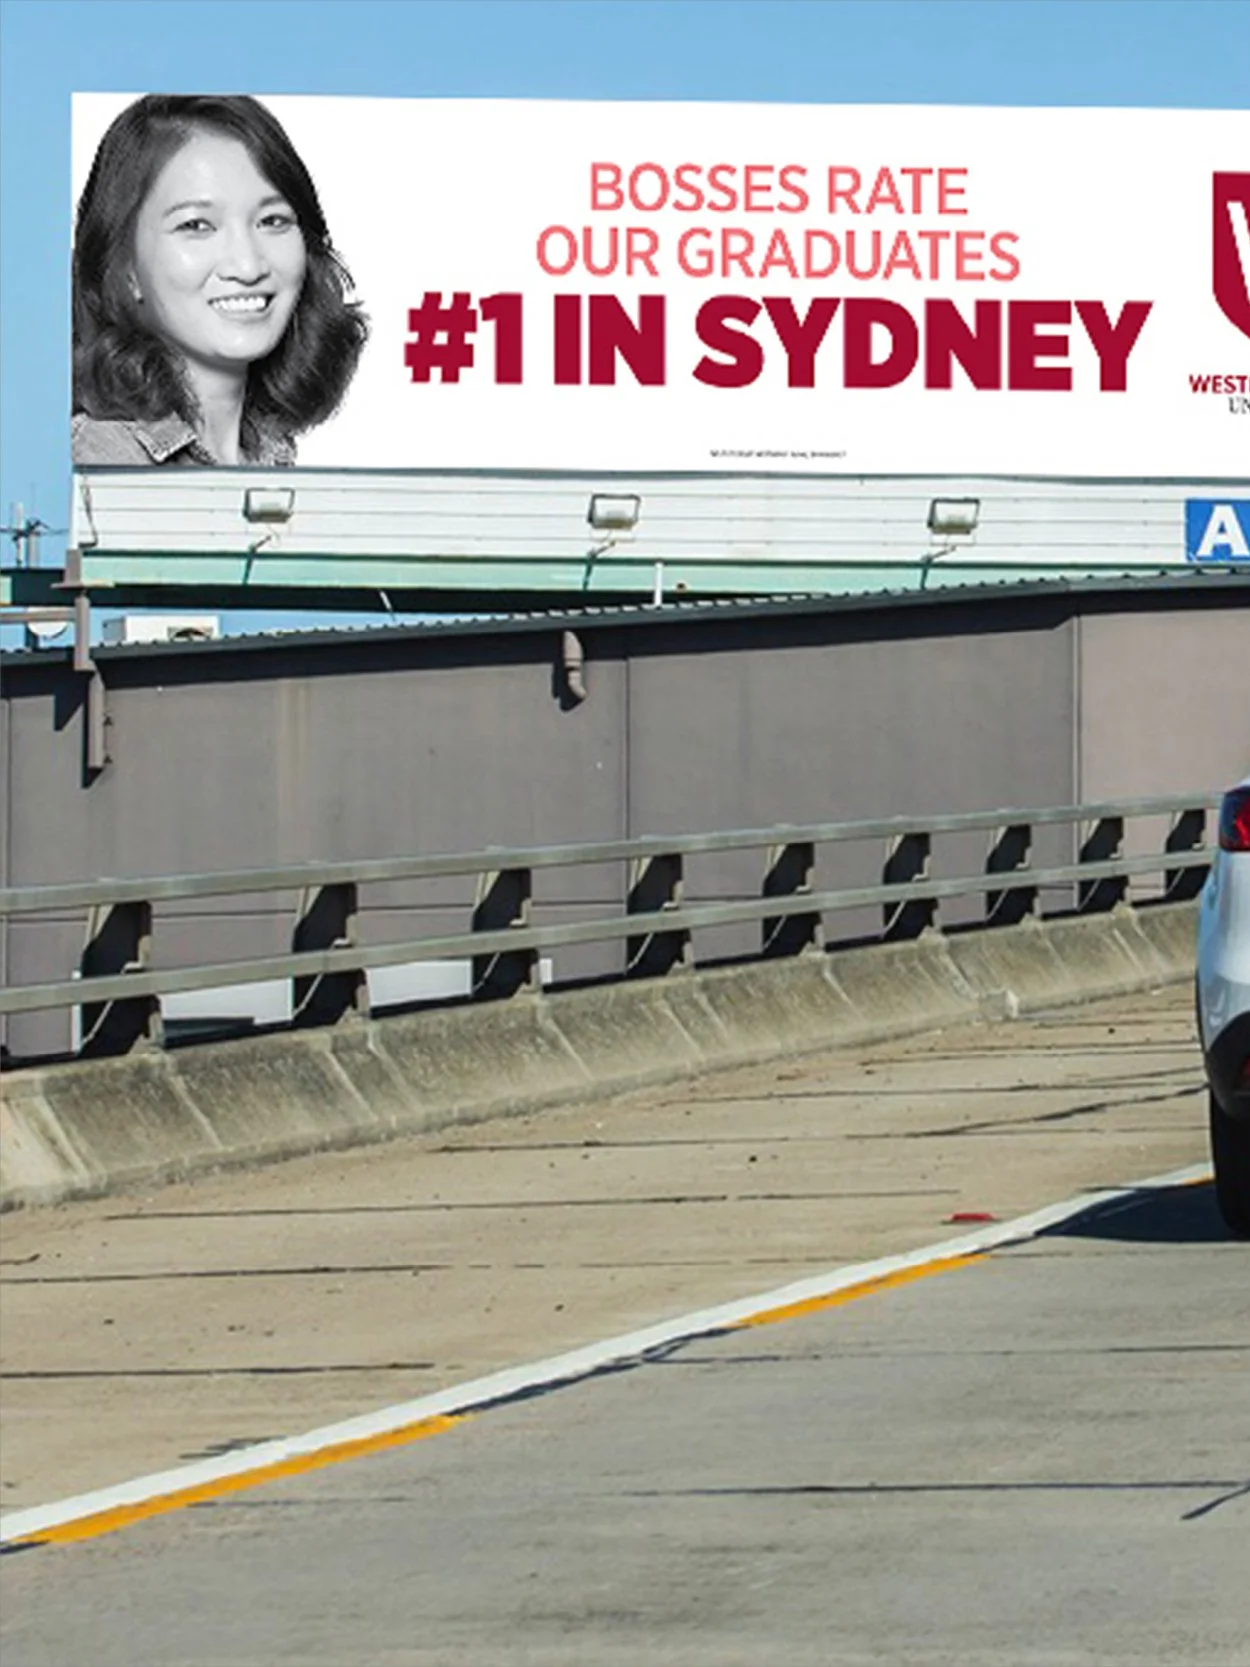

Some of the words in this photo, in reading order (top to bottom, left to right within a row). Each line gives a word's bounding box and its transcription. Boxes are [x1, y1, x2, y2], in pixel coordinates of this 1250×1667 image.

[590, 161, 810, 214] BOSSES
[827, 165, 969, 216] RATE
[535, 224, 660, 278] OUR
[677, 226, 1021, 282] GRADUATES
[403, 290, 524, 386] #1
[552, 293, 667, 388] IN
[691, 293, 1155, 393] SYDNEY
